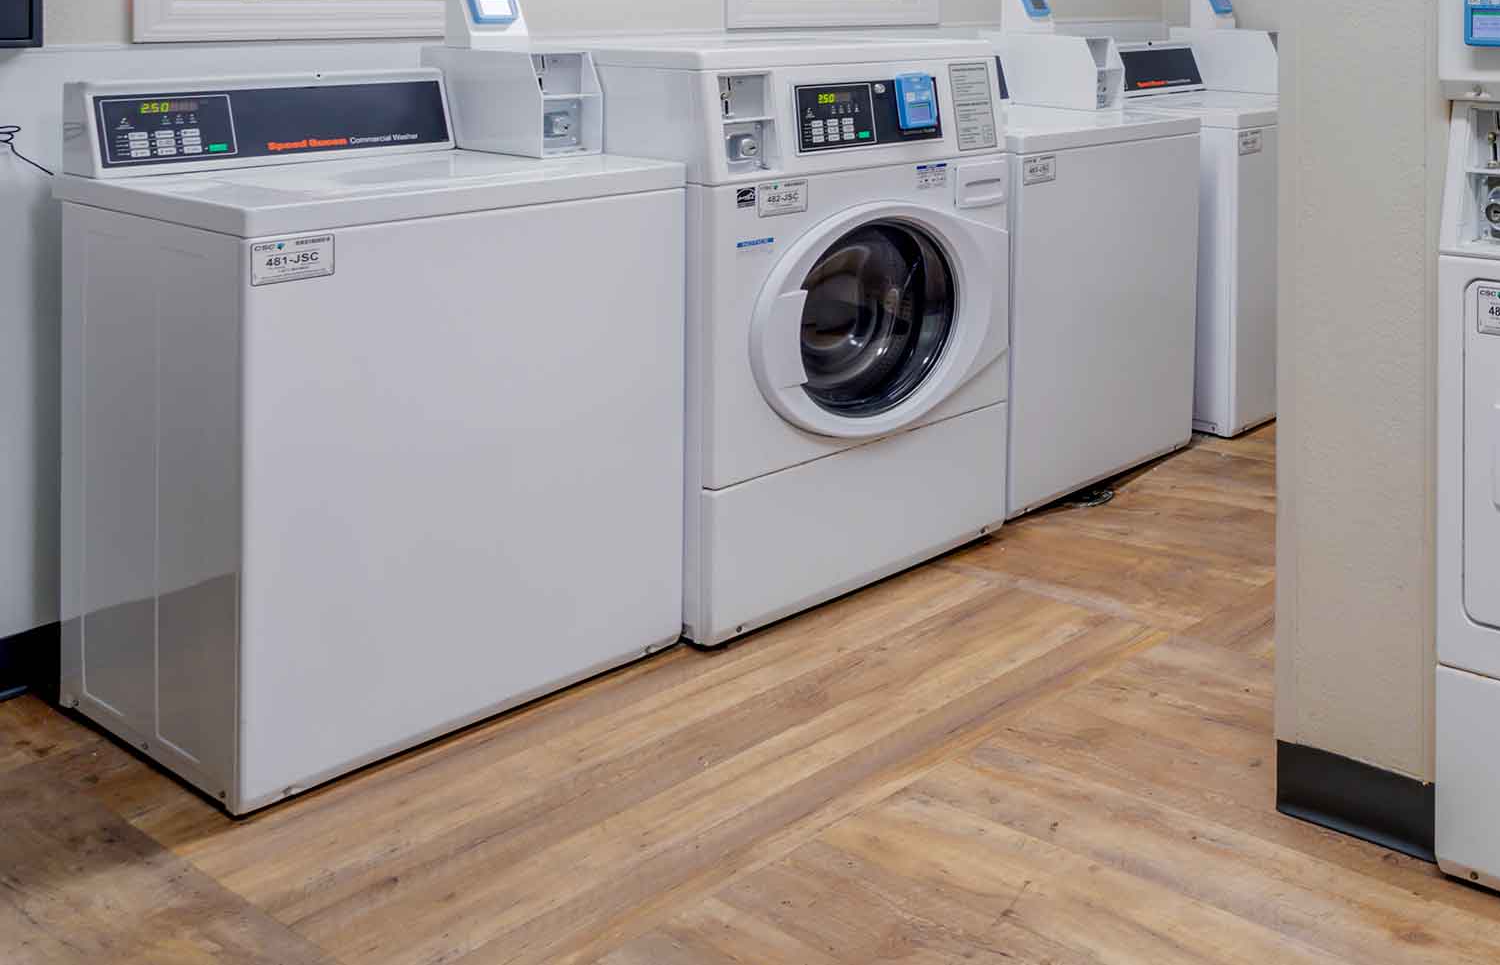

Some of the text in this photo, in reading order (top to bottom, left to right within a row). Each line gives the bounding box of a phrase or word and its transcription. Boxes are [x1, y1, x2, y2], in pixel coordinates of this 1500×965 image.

[818, 93, 835, 104] 250
[140, 102, 169, 114] 250
[267, 133, 418, 151] Speed Queen Commercial Washer
[265, 251, 319, 267] 481-JSC
